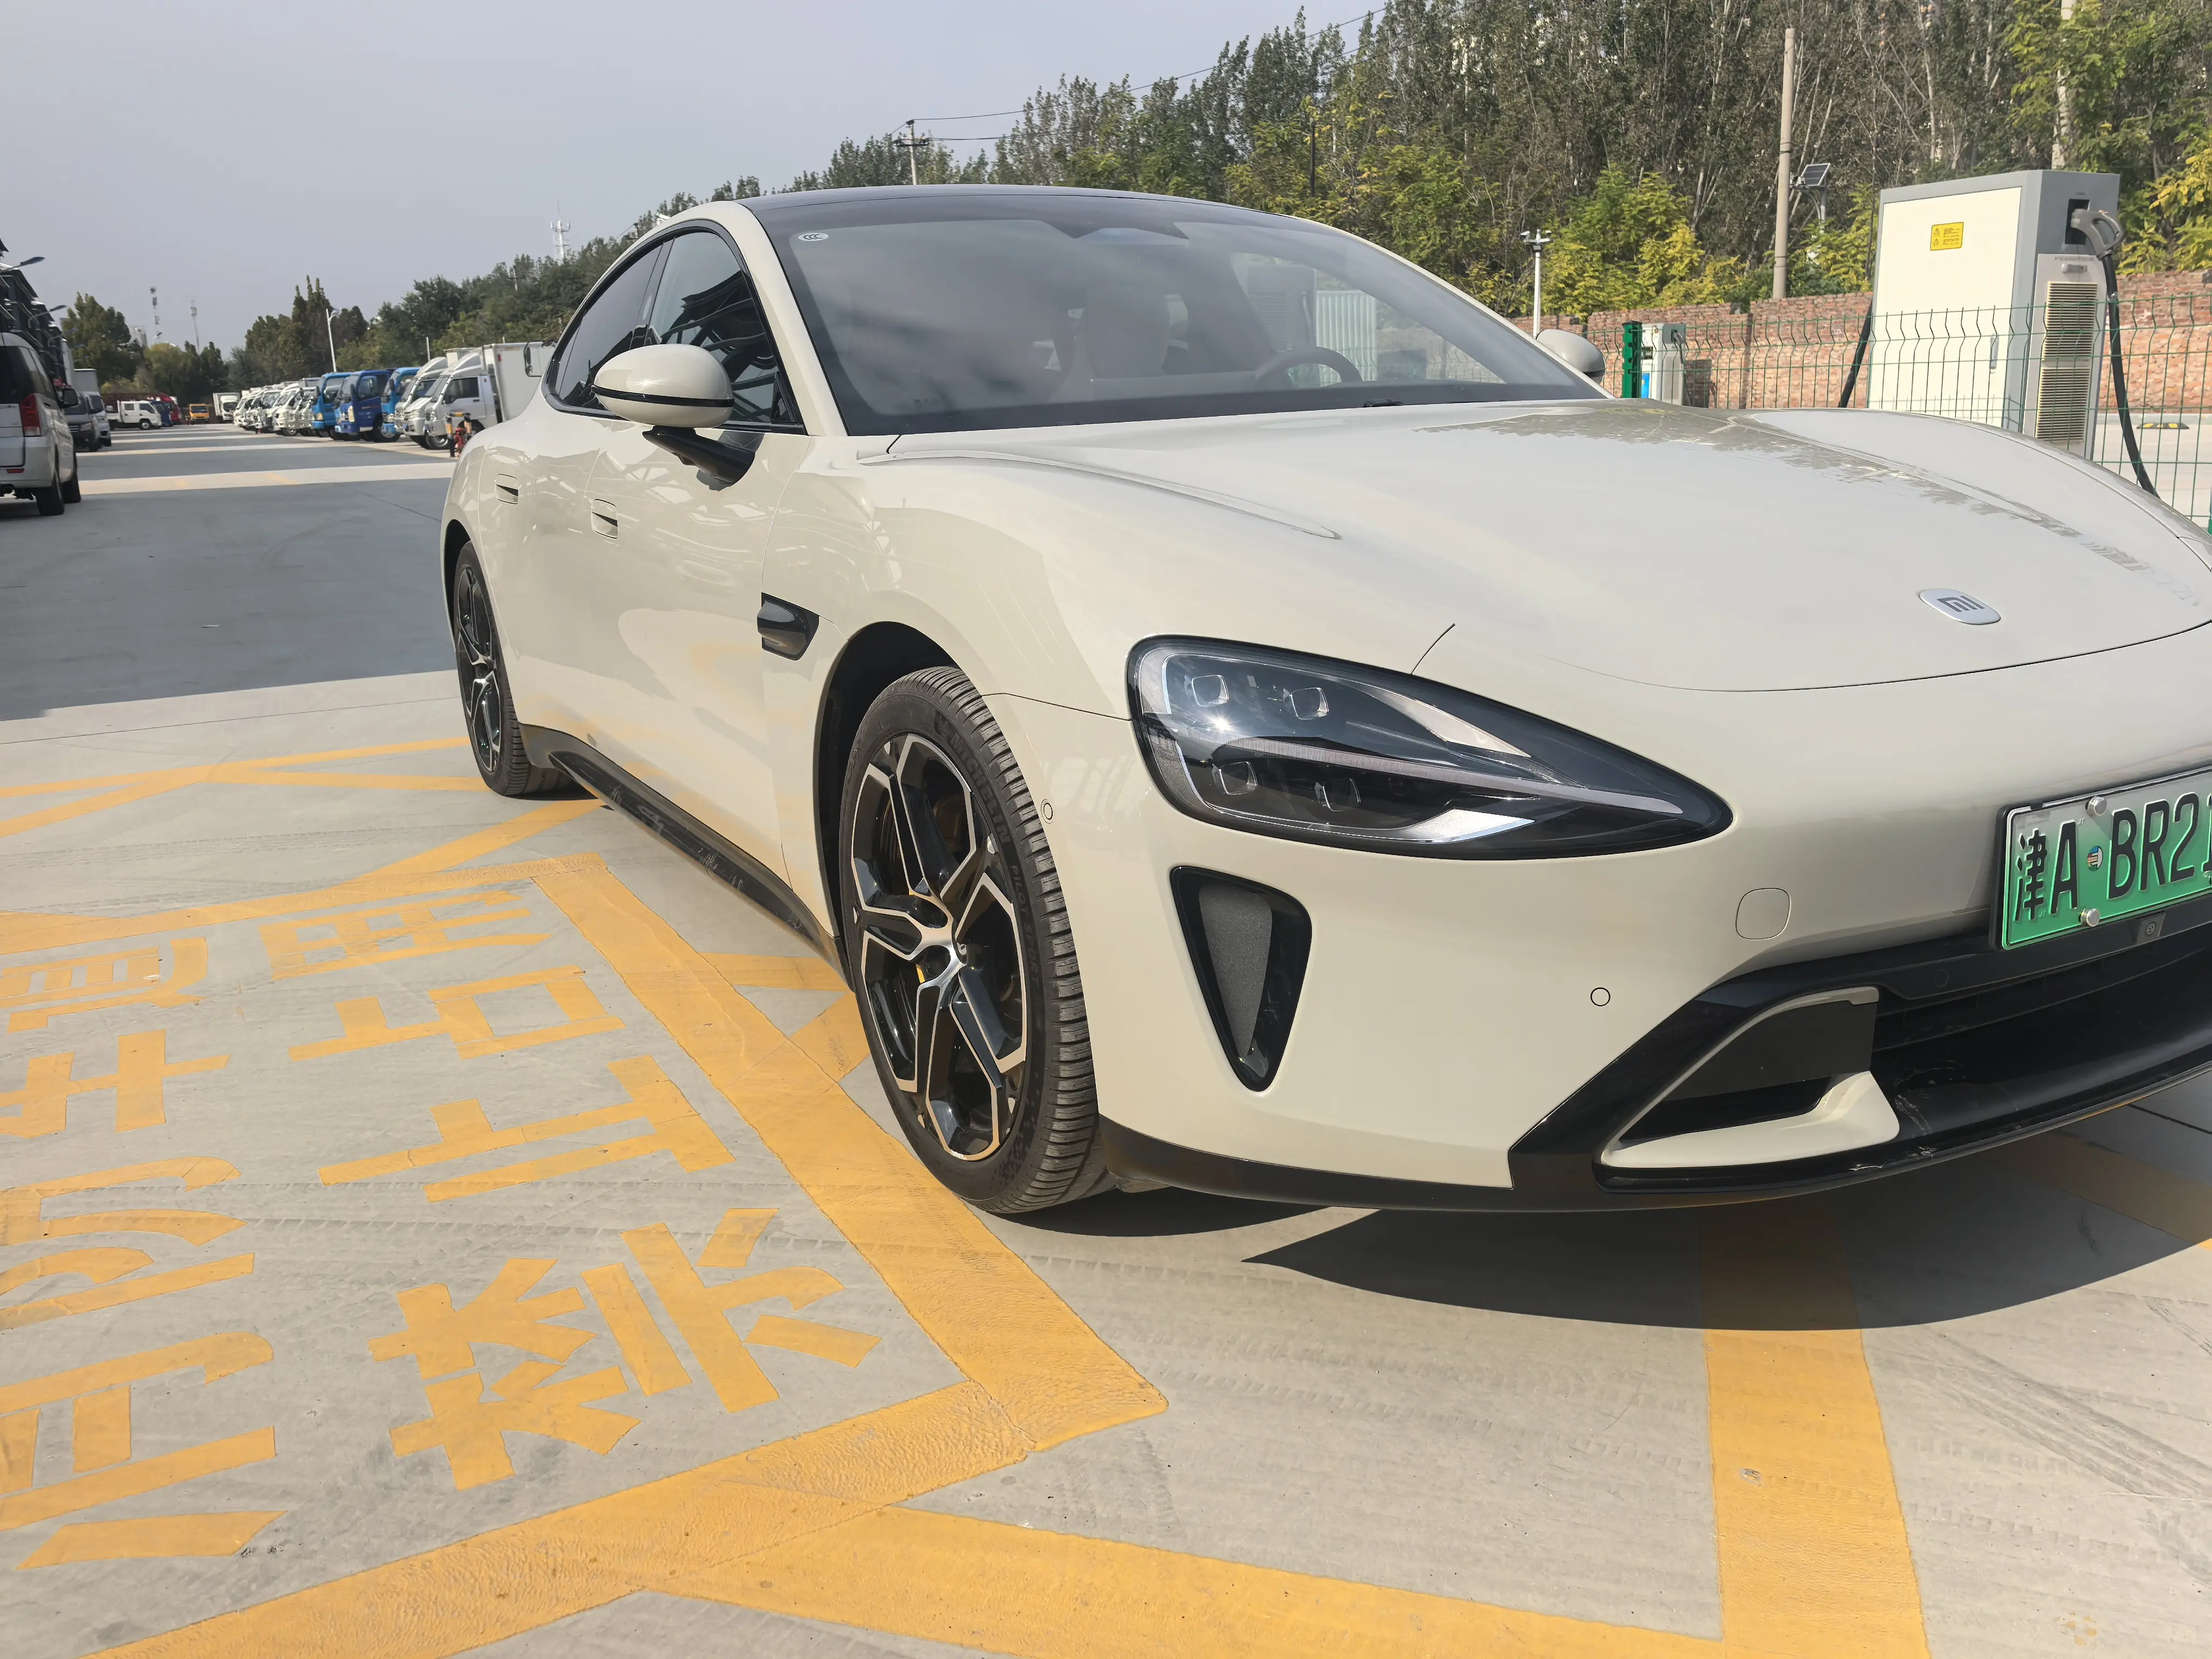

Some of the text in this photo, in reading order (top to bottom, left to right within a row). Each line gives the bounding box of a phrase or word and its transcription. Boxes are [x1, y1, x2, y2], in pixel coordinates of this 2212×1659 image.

[949, 733, 1011, 844] MICHELIN
[1009, 865, 1029, 918] PILOT
[1023, 922, 1040, 988] SPORT
[258, 890, 882, 1492] 禁止占用
